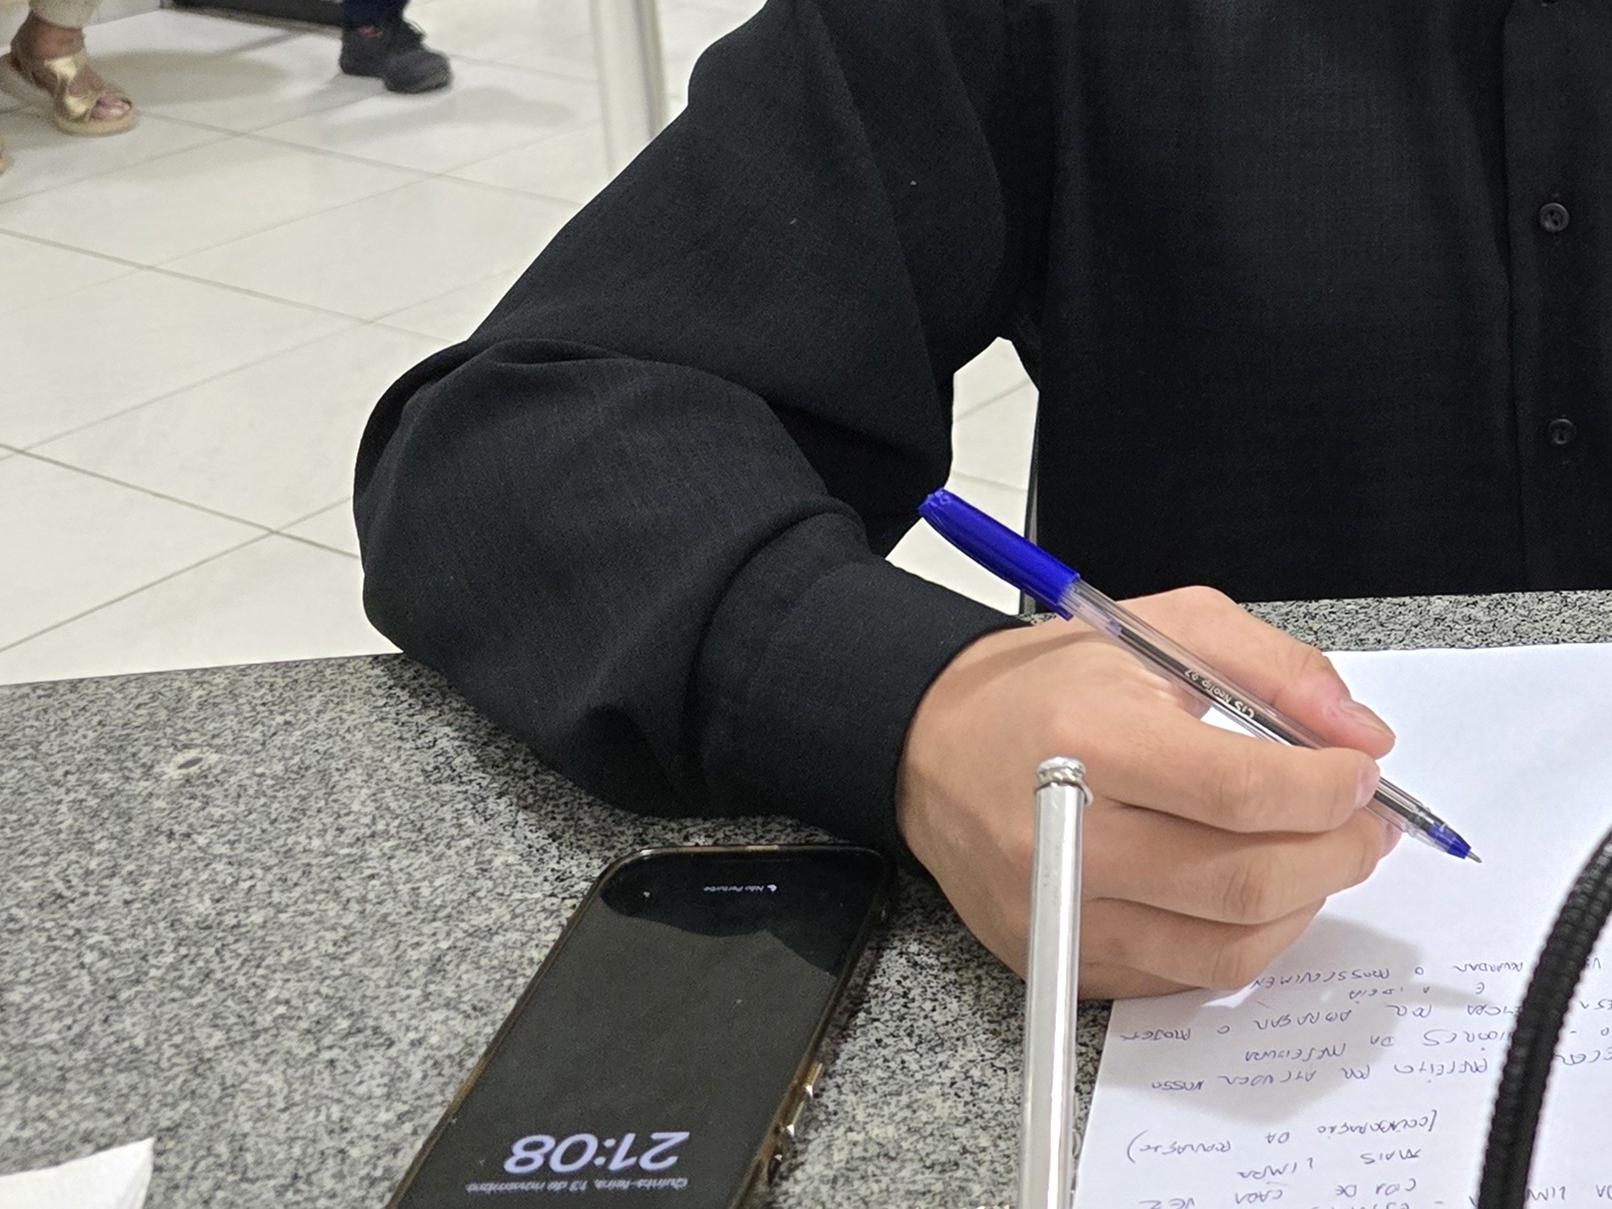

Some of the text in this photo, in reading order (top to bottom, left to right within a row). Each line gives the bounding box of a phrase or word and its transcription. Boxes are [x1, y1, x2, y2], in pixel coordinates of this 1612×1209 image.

[1414, 966, 1424, 976] O
[1475, 981, 1485, 995] E
[1264, 1131, 1290, 1144] DA
[503, 1131, 690, 1174] 21:08
[547, 1181, 568, 1192] de
